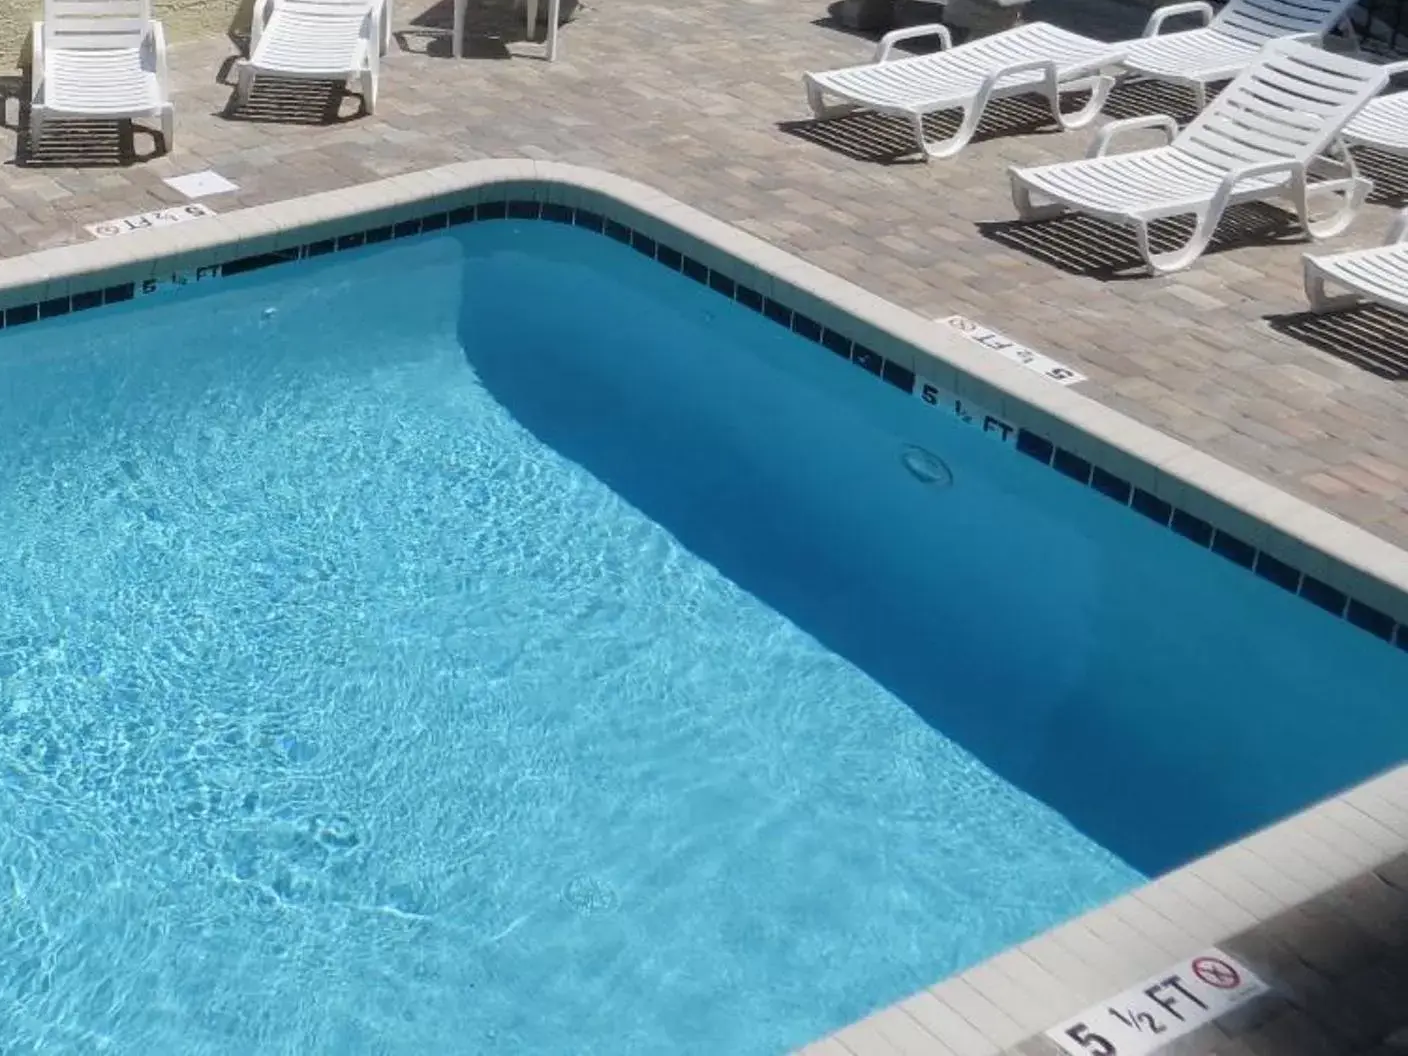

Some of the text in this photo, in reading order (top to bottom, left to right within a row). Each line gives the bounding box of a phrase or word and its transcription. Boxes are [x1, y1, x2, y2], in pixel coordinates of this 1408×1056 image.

[185, 206, 205, 217] 5
[124, 216, 152, 230] FT
[142, 278, 157, 294] 5
[196, 264, 220, 281] FT
[973, 334, 1013, 350] FT
[1046, 368, 1073, 380] 5
[921, 384, 938, 405] 5
[983, 415, 1013, 442] FT
[1065, 1022, 1116, 1056] 5
[1144, 974, 1209, 1021] FT
